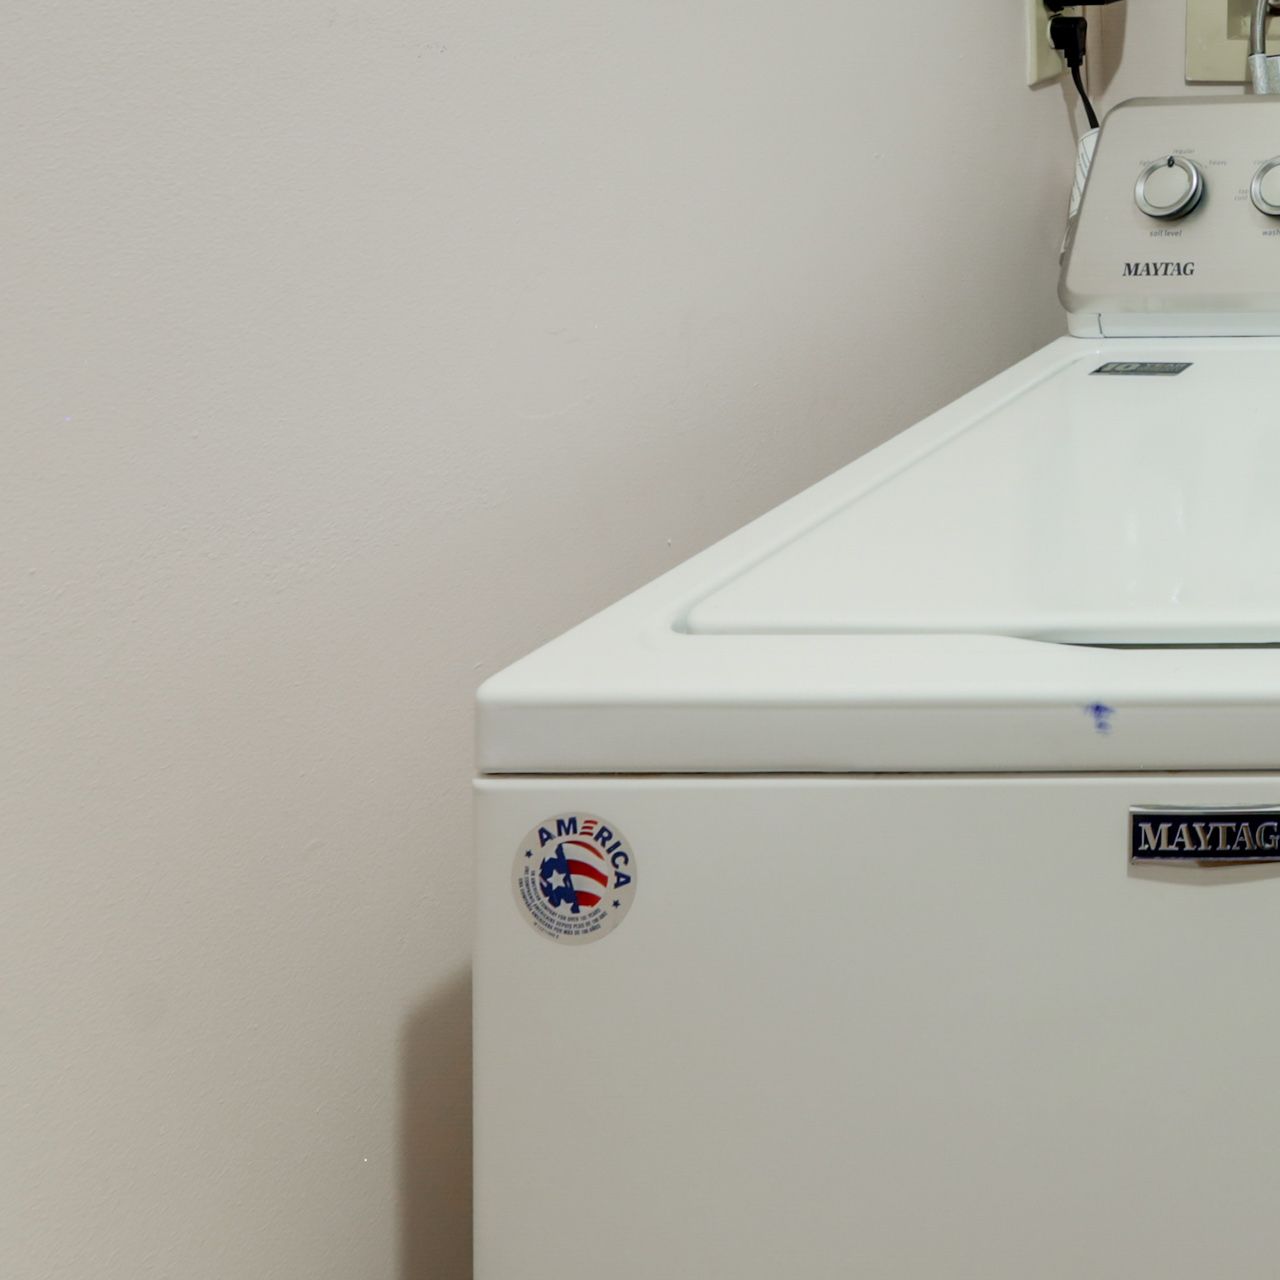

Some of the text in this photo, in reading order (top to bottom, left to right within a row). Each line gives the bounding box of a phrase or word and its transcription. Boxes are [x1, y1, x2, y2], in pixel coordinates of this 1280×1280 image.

[1150, 229, 1183, 238] soil level
[1262, 228, 1279, 236] wash
[1122, 262, 1196, 277] MAYTAG
[1100, 362, 1140, 372] 10
[1138, 822, 1280, 851] MAYTAG
[538, 817, 632, 889] AMERICA
